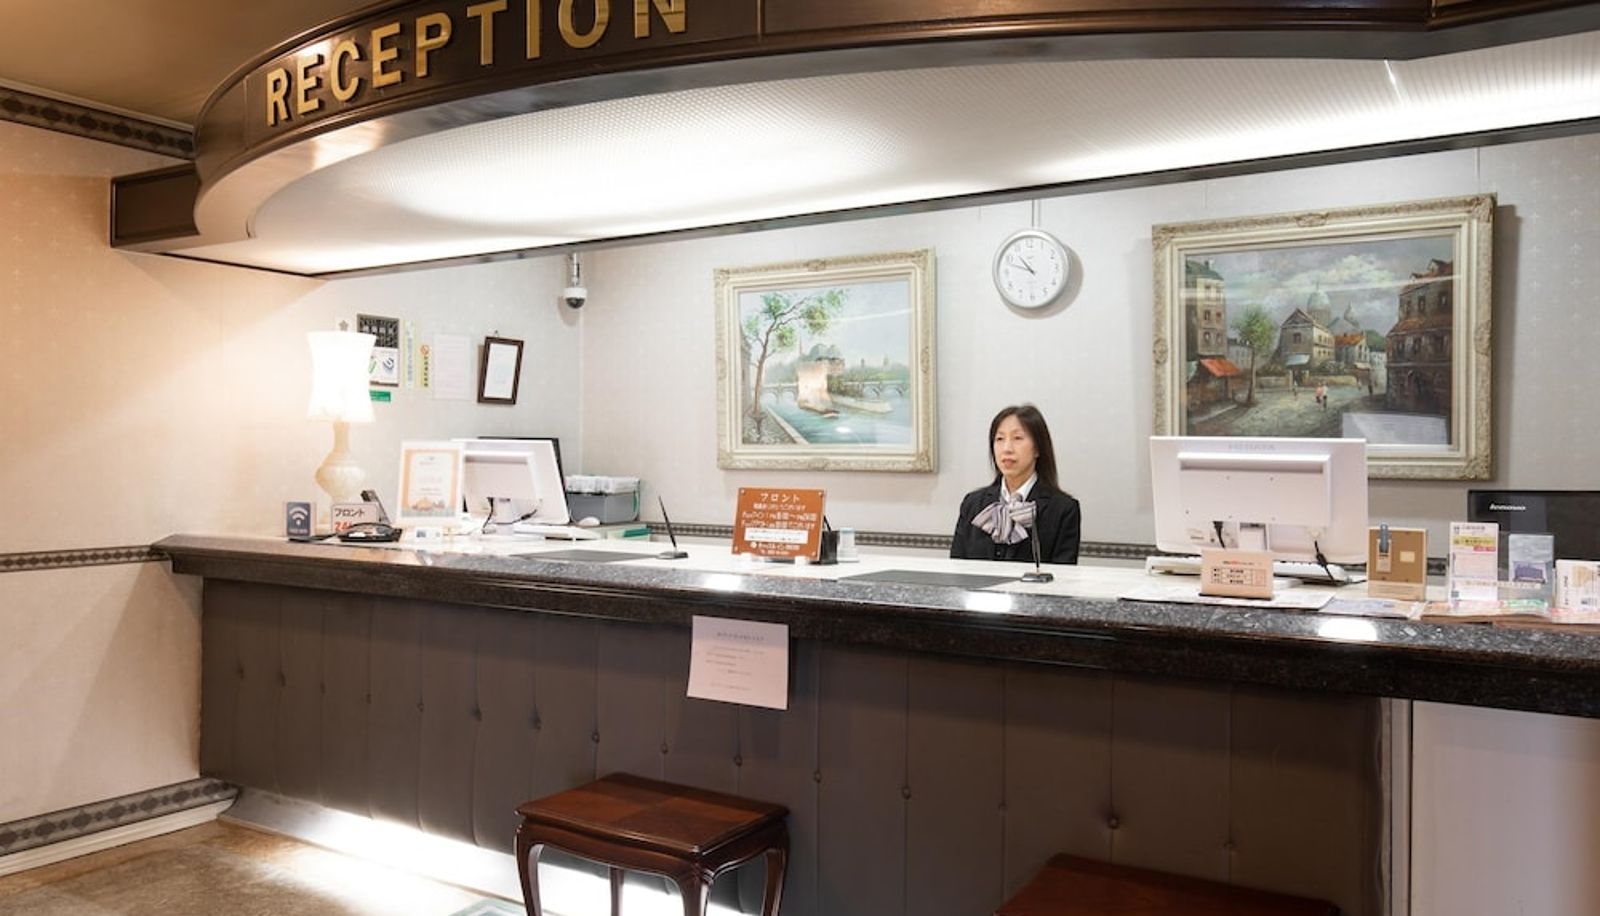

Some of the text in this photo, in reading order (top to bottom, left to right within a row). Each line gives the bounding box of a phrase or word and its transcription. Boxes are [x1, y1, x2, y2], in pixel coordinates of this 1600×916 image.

[266, 0, 687, 127] RECEPTION
[760, 493, 801, 503] フロント
[334, 508, 365, 517] フロント
